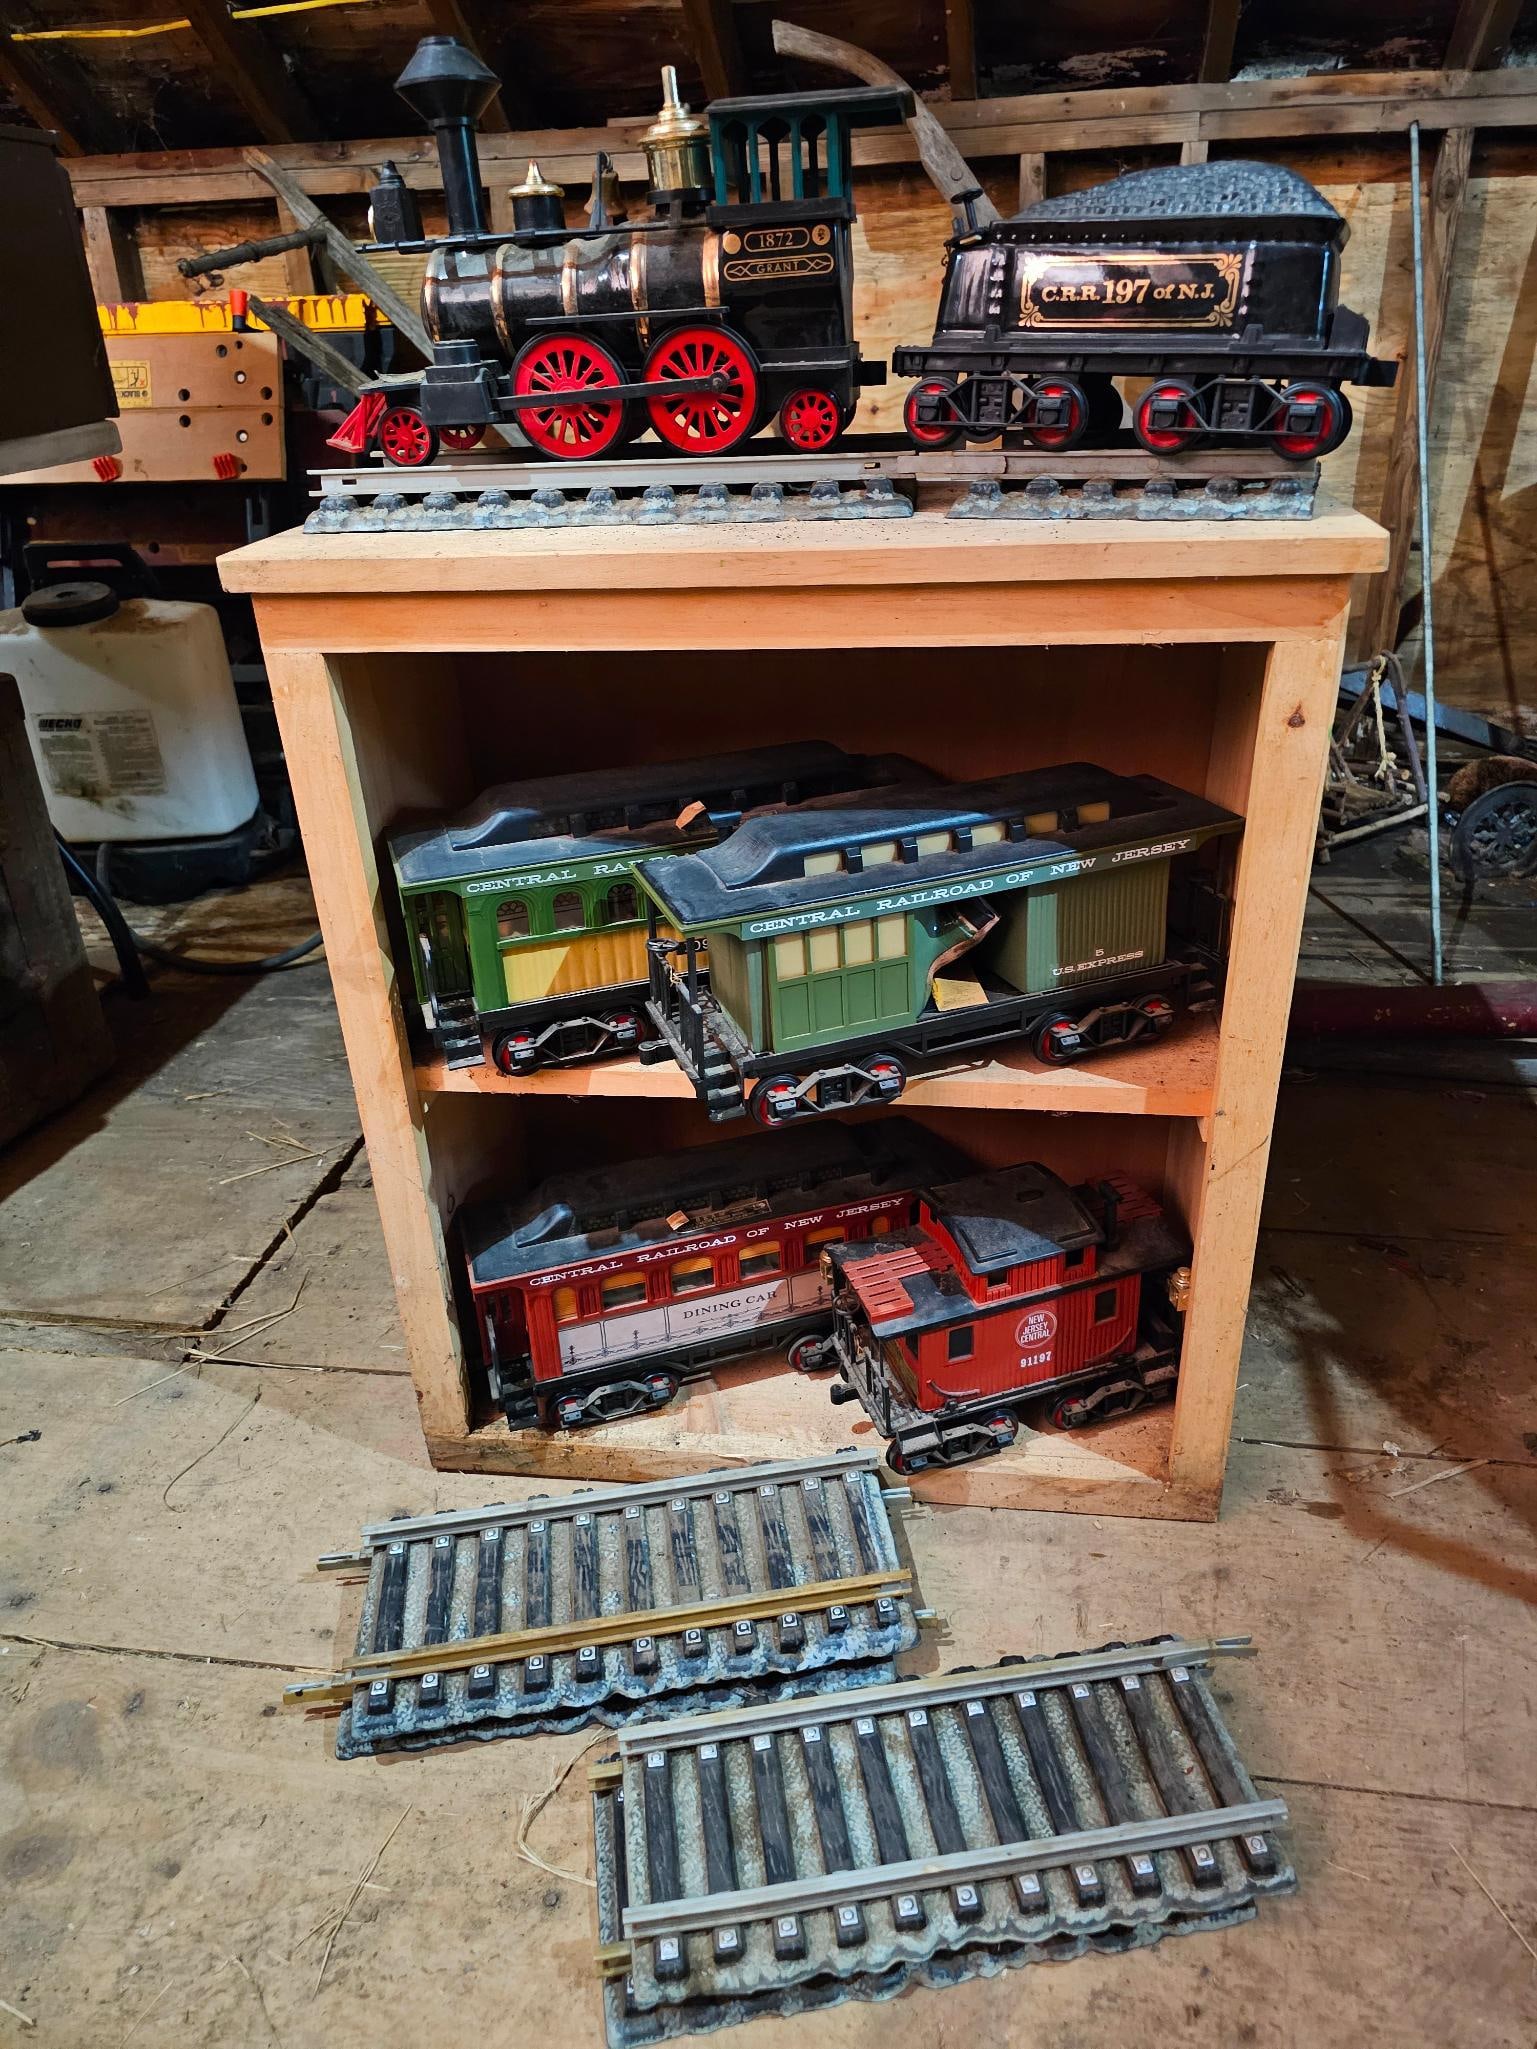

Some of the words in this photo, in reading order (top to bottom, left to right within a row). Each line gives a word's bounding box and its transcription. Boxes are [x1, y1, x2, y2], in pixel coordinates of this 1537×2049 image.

[759, 232, 793, 248] 1872
[756, 261, 800, 274] GRANT
[1102, 279, 1151, 304] 197
[1153, 284, 1175, 300] of
[1177, 284, 1215, 300] N.J.
[466, 869, 577, 893] CENTRAL
[749, 906, 860, 933] CENTRAL
[876, 879, 994, 911] RAILROAD
[1005, 870, 1034, 884] OF
[1050, 858, 1097, 876] NEW
[1111, 838, 1192, 863] JERSEY
[1077, 950, 1144, 971] EXPRESS
[1095, 948, 1105, 957] 5
[529, 1260, 623, 1286] CENTRAL
[636, 1235, 737, 1263] RAILROAD
[746, 1227, 770, 1238] OF
[784, 1215, 824, 1230] NEW
[836, 1197, 905, 1219] JERSEY
[683, 1299, 742, 1319] DINING
[745, 1290, 778, 1304] CAR
[1028, 1313, 1045, 1324] NEW
[1020, 1329, 1050, 1343] CENTRAL
[1022, 1321, 1049, 1335] JERSEY
[1020, 1351, 1052, 1368] 91197
